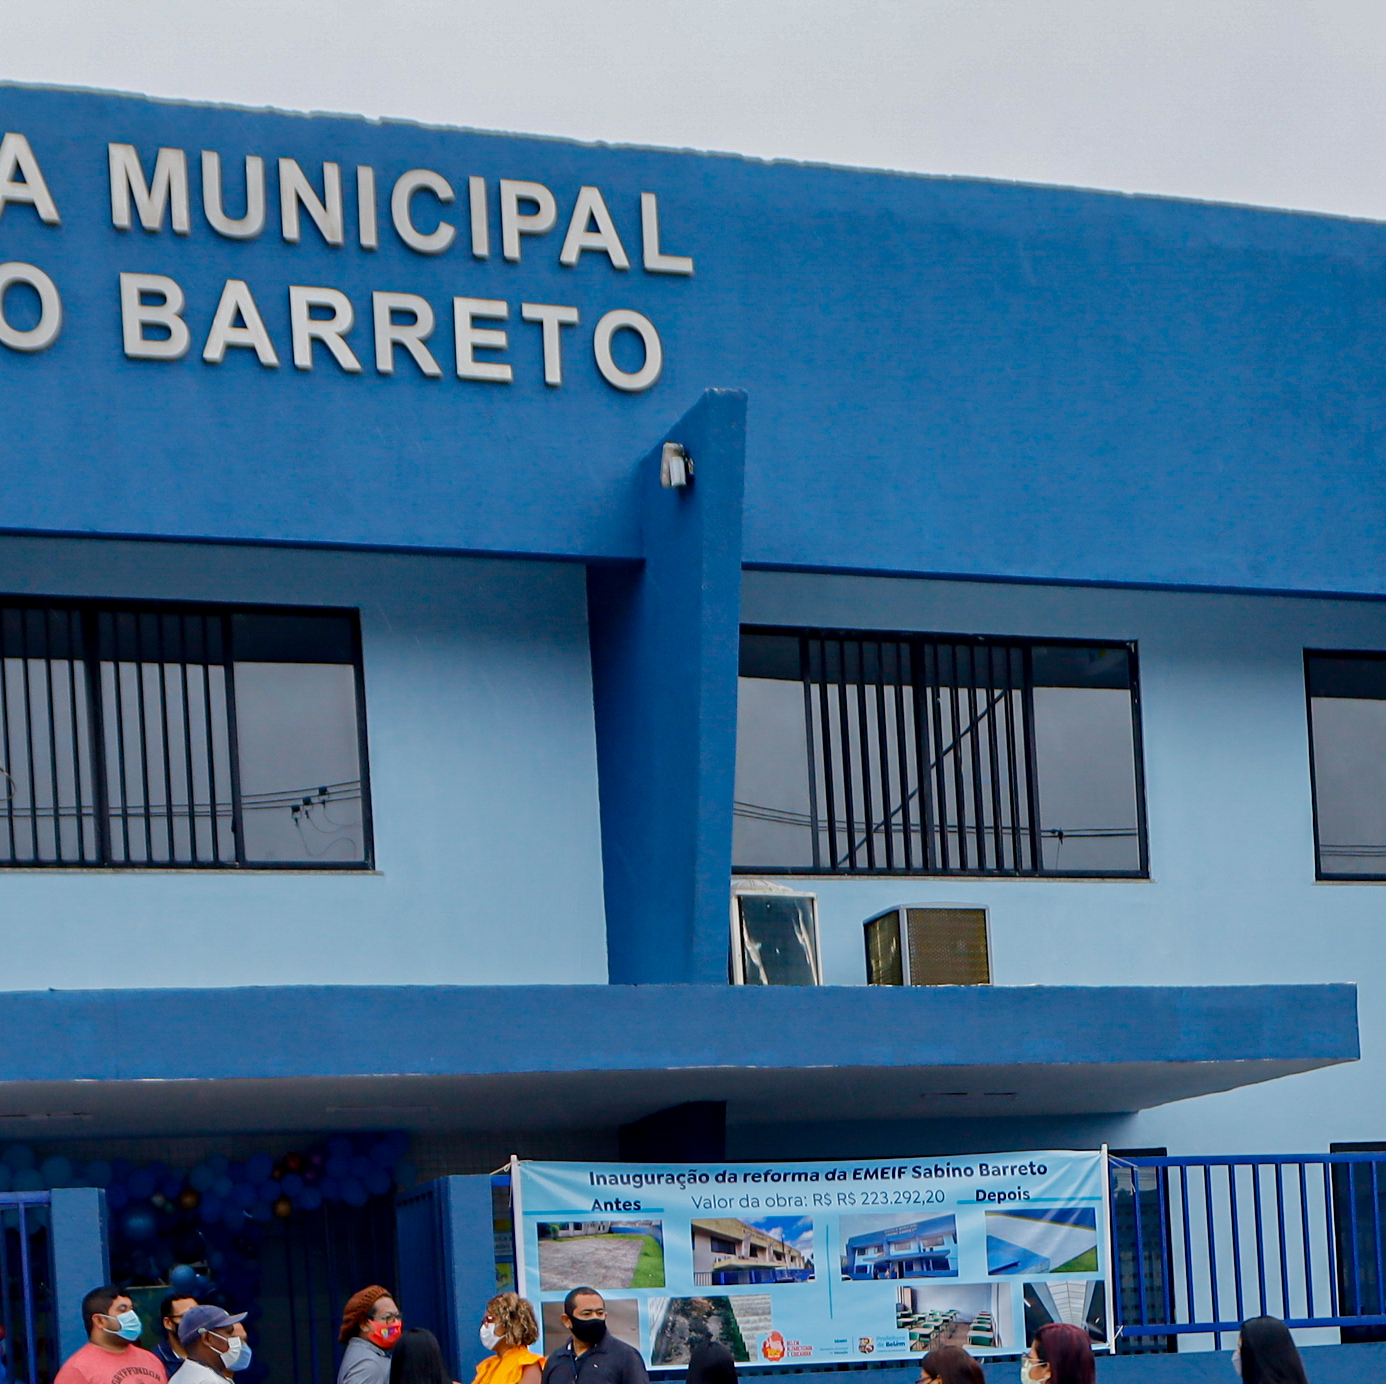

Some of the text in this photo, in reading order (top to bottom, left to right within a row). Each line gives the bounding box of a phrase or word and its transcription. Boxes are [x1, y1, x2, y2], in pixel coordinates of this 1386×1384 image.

[108, 142, 695, 275] MUNICIPAL
[119, 271, 663, 391] BARRETO
[589, 1160, 1048, 1190] Inauguração da reforma da EMEIF Sabino Barreto
[591, 1198, 641, 1211] Antes
[691, 1189, 945, 1209] Valor da obra: R$ R$ 223.292,20
[975, 1185, 1031, 1204] Depois
